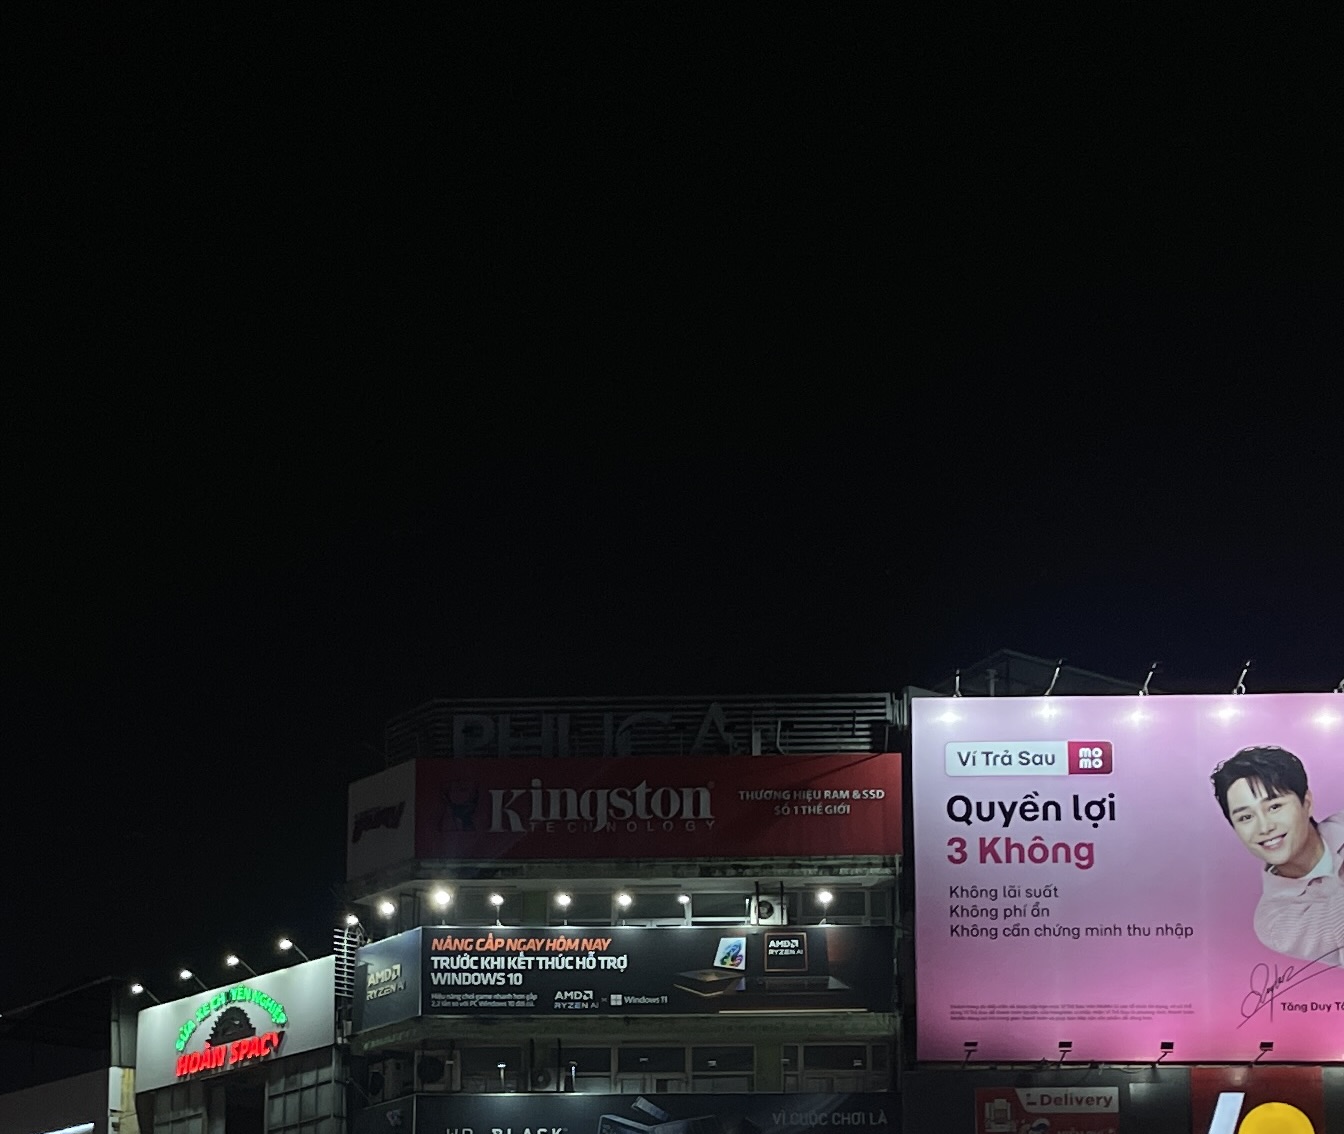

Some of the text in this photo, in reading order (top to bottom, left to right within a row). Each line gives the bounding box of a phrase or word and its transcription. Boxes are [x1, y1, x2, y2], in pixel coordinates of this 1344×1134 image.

[957, 749, 1055, 766] Ví Trả Sau
[738, 789, 790, 801] THƯƠNG
[793, 789, 822, 802] HIỆU
[824, 790, 850, 800] RAM
[862, 789, 885, 800] SSD
[488, 778, 715, 833] Kingston
[774, 804, 791, 816] SỐ
[799, 804, 823, 816] THẾ
[824, 804, 851, 815] GIỚI
[947, 791, 1116, 828] Quyền lợi
[947, 836, 1094, 870] 3 Không
[950, 884, 1059, 900] Không lãi suất
[950, 902, 1050, 920] Không phí ẩn
[950, 924, 998, 939] Không
[1035, 924, 1080, 939] chứng
[1085, 924, 1122, 937] minh
[1127, 924, 1150, 937] thu
[1156, 923, 1194, 939] nhập
[431, 932, 612, 951] NÂNG CẤP NGAY HÔM NAY
[769, 939, 792, 948] AMD
[431, 951, 628, 973] TRƯỚC KHI KẾT THÚC HỖ TRỢ
[368, 965, 396, 987] AMD
[431, 973, 523, 986] WINDOWS 10
[555, 990, 586, 1000] AMD
[624, 995, 660, 1005] Windows
[1281, 1001, 1308, 1013] Tăng
[1310, 1002, 1332, 1013] Duy
[176, 1041, 227, 1077] HOÀN
[1040, 1093, 1113, 1108] Delivery
[773, 1109, 786, 1125] VÌ
[832, 1110, 866, 1125] CHƠI
[870, 1109, 888, 1125] LÀ
